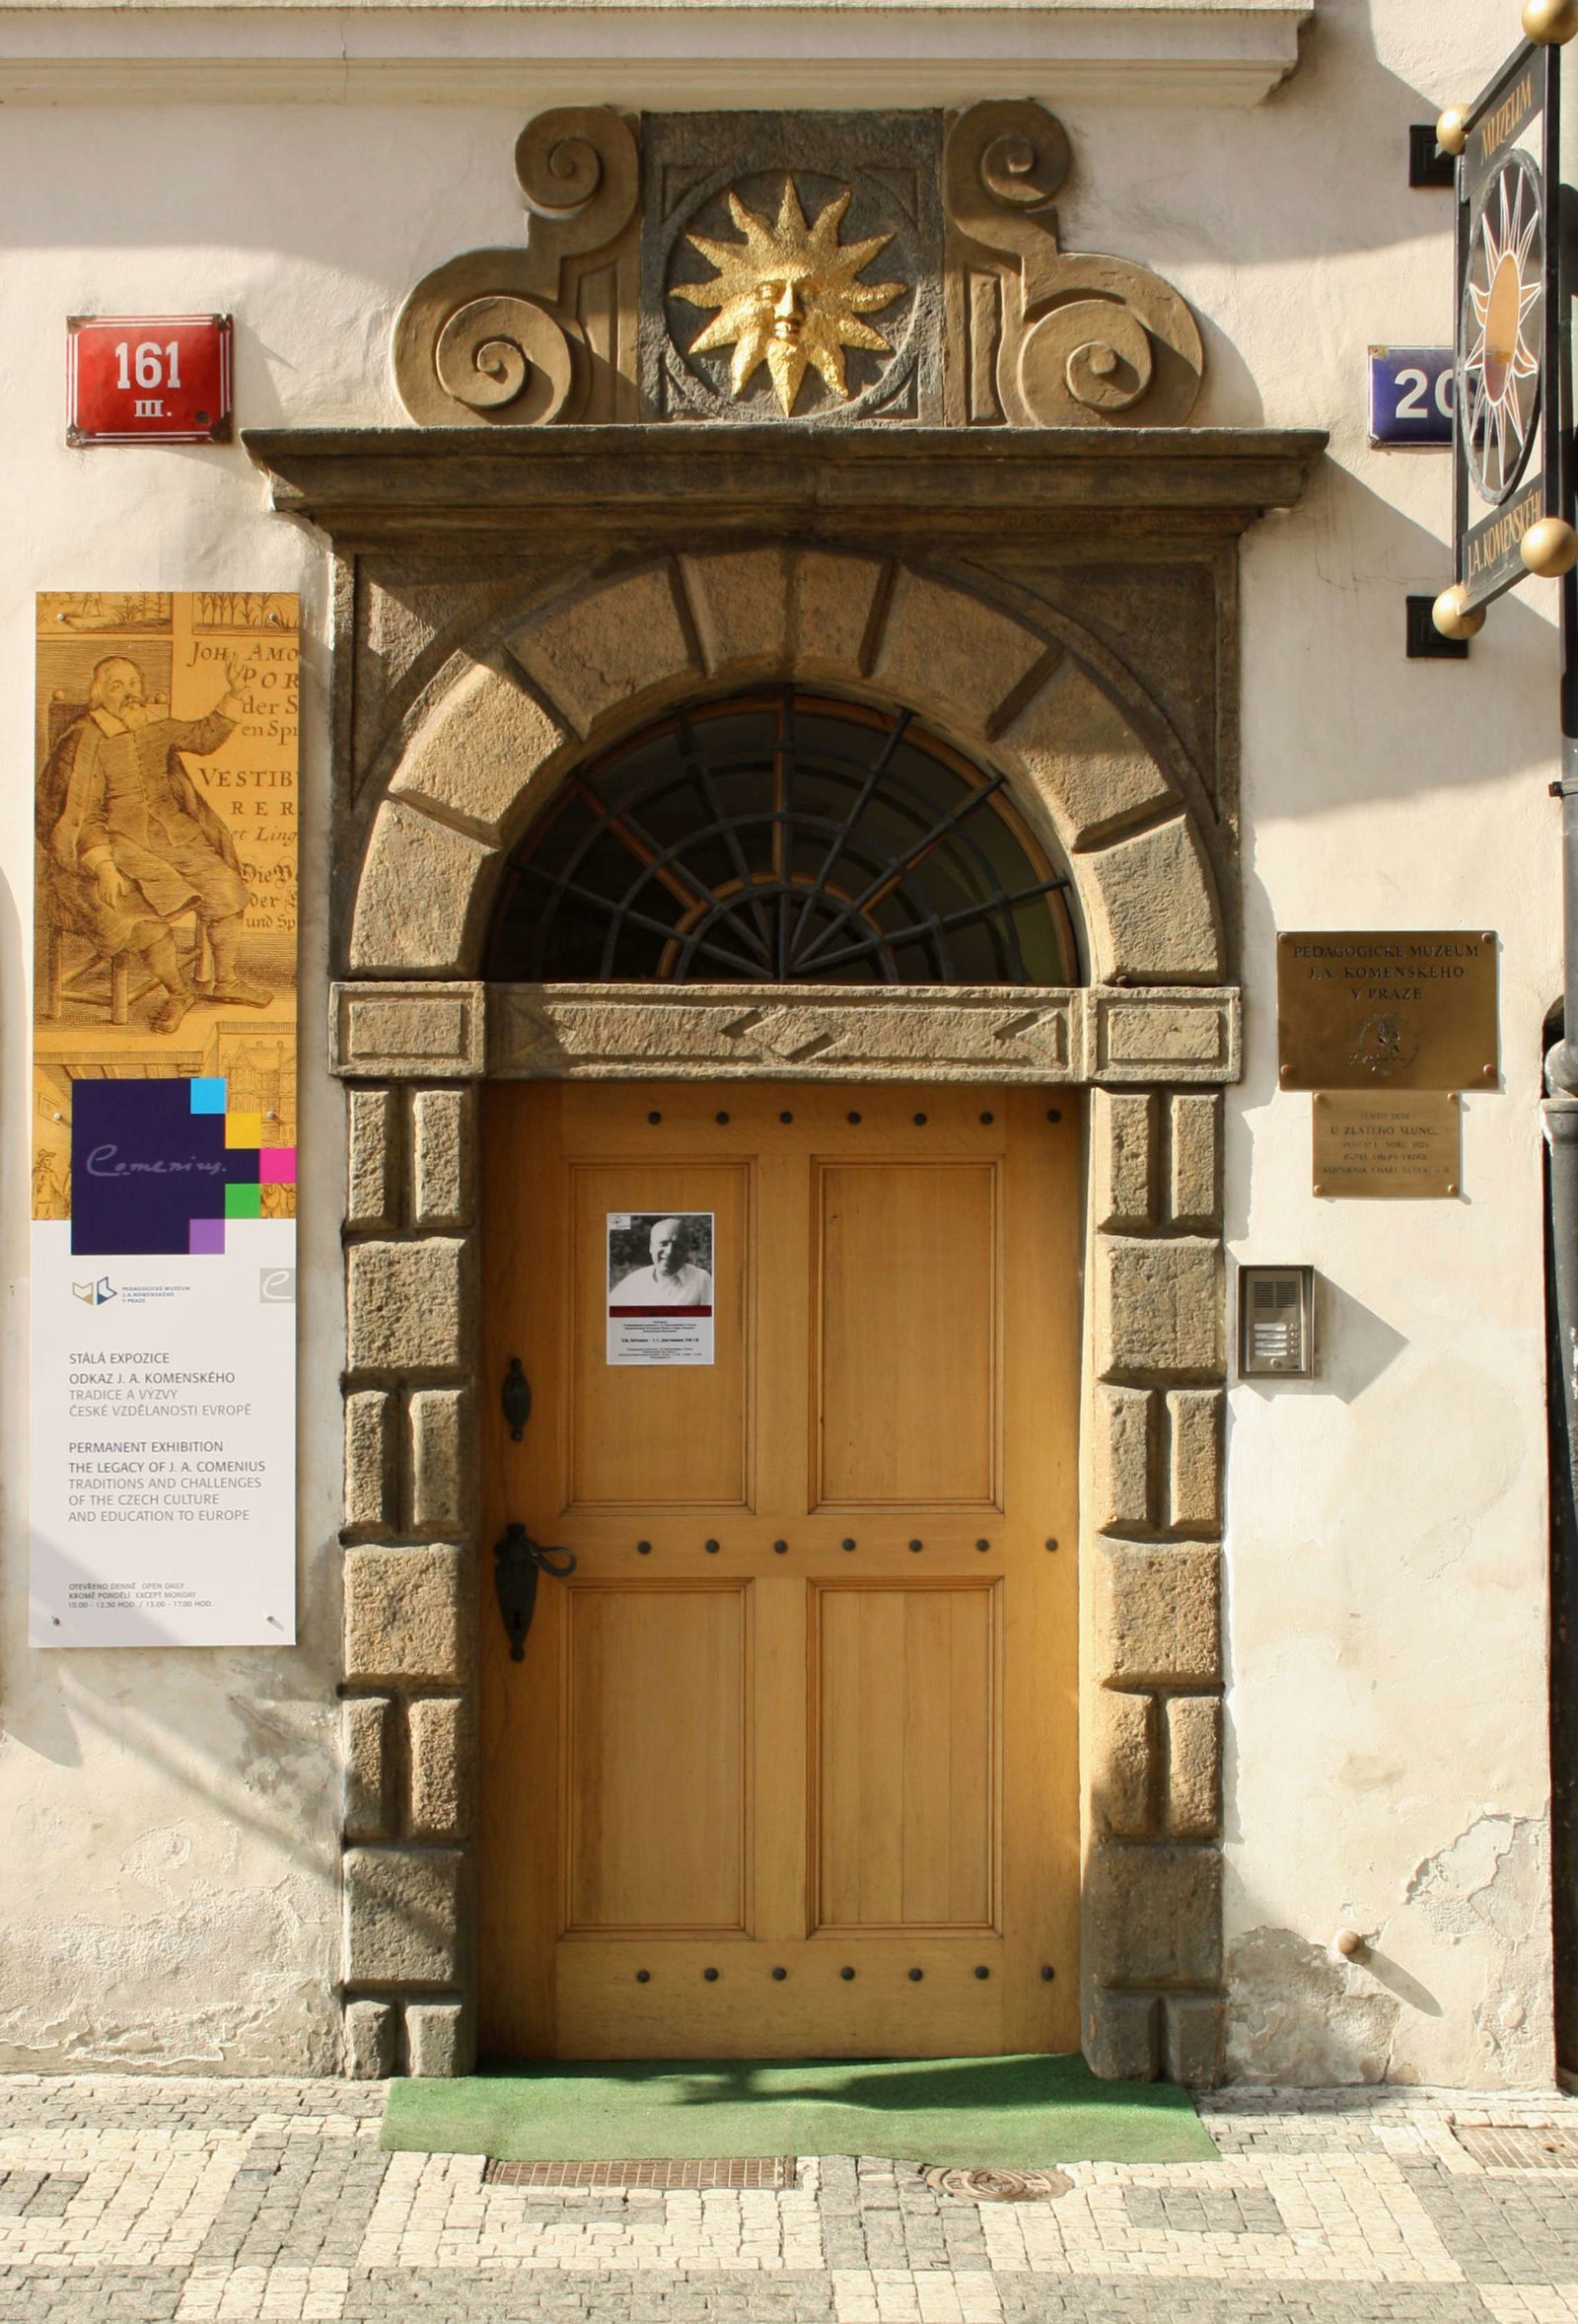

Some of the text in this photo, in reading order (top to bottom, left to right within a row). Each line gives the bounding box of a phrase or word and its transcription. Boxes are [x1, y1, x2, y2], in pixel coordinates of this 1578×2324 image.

[1481, 72, 1532, 166] MUZEUM
[115, 341, 180, 389] 161
[134, 399, 172, 417] III.
[242, 694, 279, 715] der
[1411, 944, 1478, 957] MUZEUM
[1351, 987, 1422, 1000] V PRAZE
[69, 1352, 170, 1364] STÁLÁ EXPOZICE
[69, 1373, 112, 1384] ODKAZ
[145, 1371, 236, 1383] KOMENSKÉHO
[69, 1387, 178, 1401] TRADICE A VÝZVY
[69, 1403, 251, 1416] ČESKÉ VZDĚLANOSTI EVROPĚ
[69, 1441, 224, 1453] PERMANENT EXHIBITION
[69, 1463, 93, 1473] THE
[98, 1462, 144, 1473] LEGACY
[148, 1462, 166, 1473] OF
[196, 1461, 265, 1472] COMENIUS
[69, 1477, 261, 1489] TRADITIONS AND CHALLENGES
[68, 1493, 220, 1505] OF THE CZECH CULTURE
[68, 1510, 250, 1521] AND EDUCATION TO EUROPE
